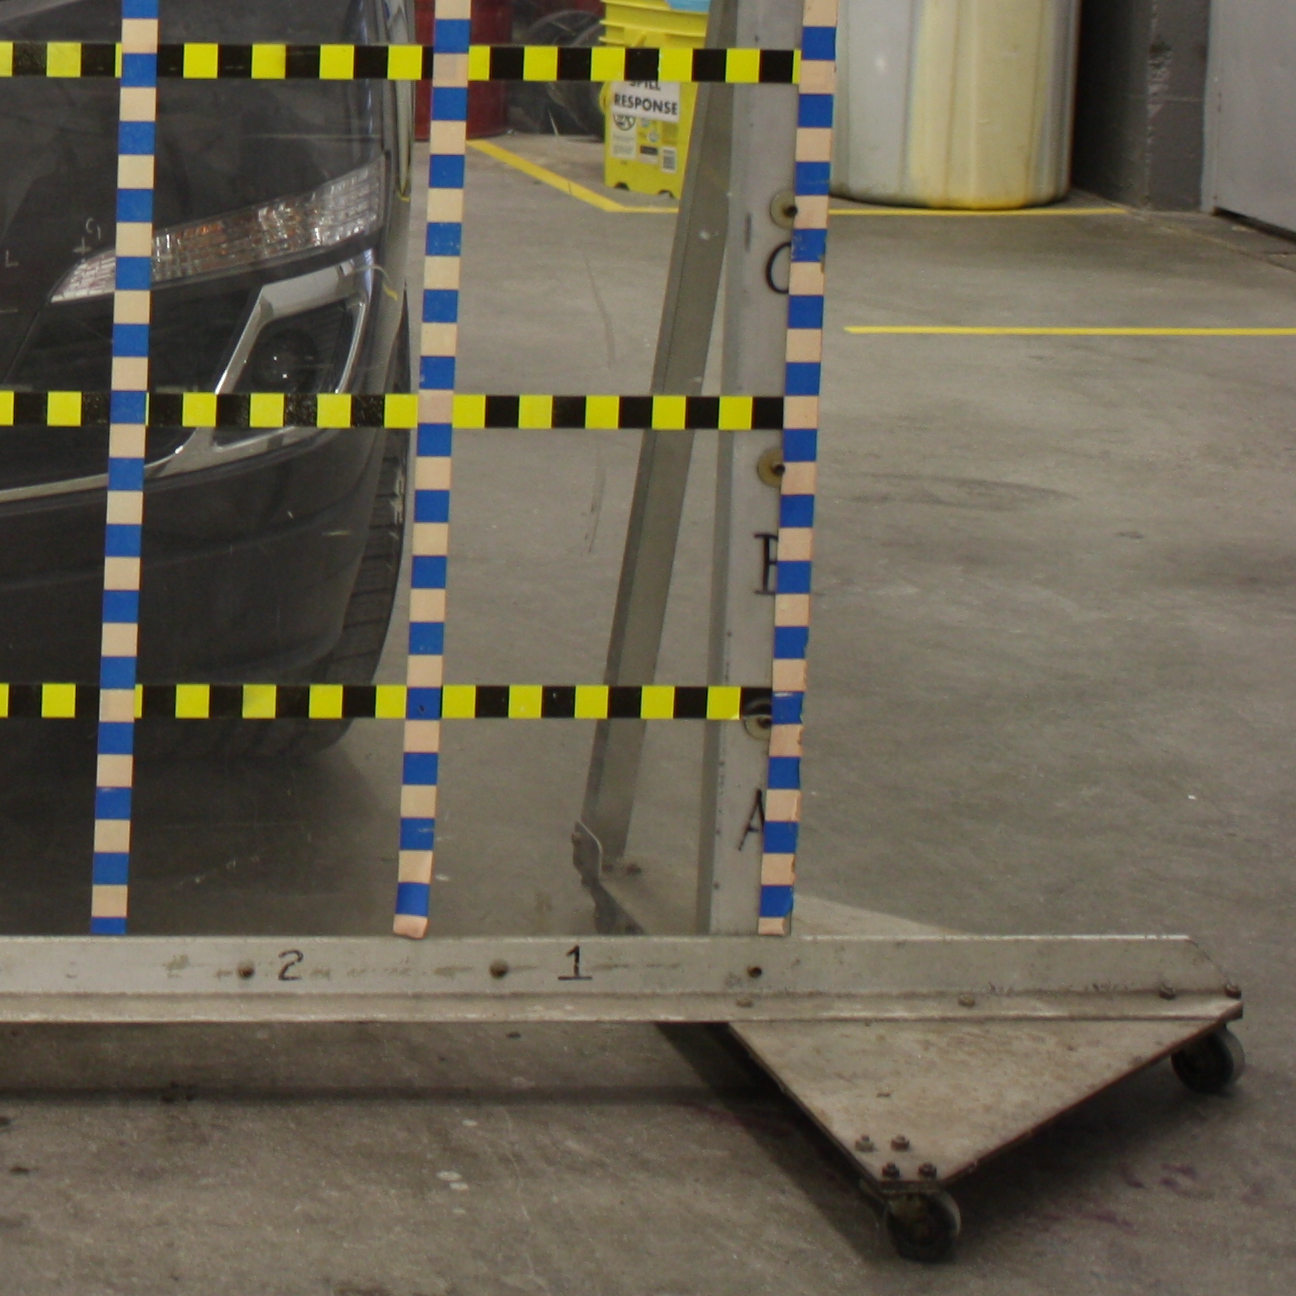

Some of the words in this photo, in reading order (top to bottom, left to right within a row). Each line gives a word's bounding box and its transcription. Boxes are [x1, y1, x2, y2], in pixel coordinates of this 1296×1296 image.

[614, 93, 678, 116] RESPONSE
[278, 949, 304, 982] 2
[557, 944, 593, 981] 1
